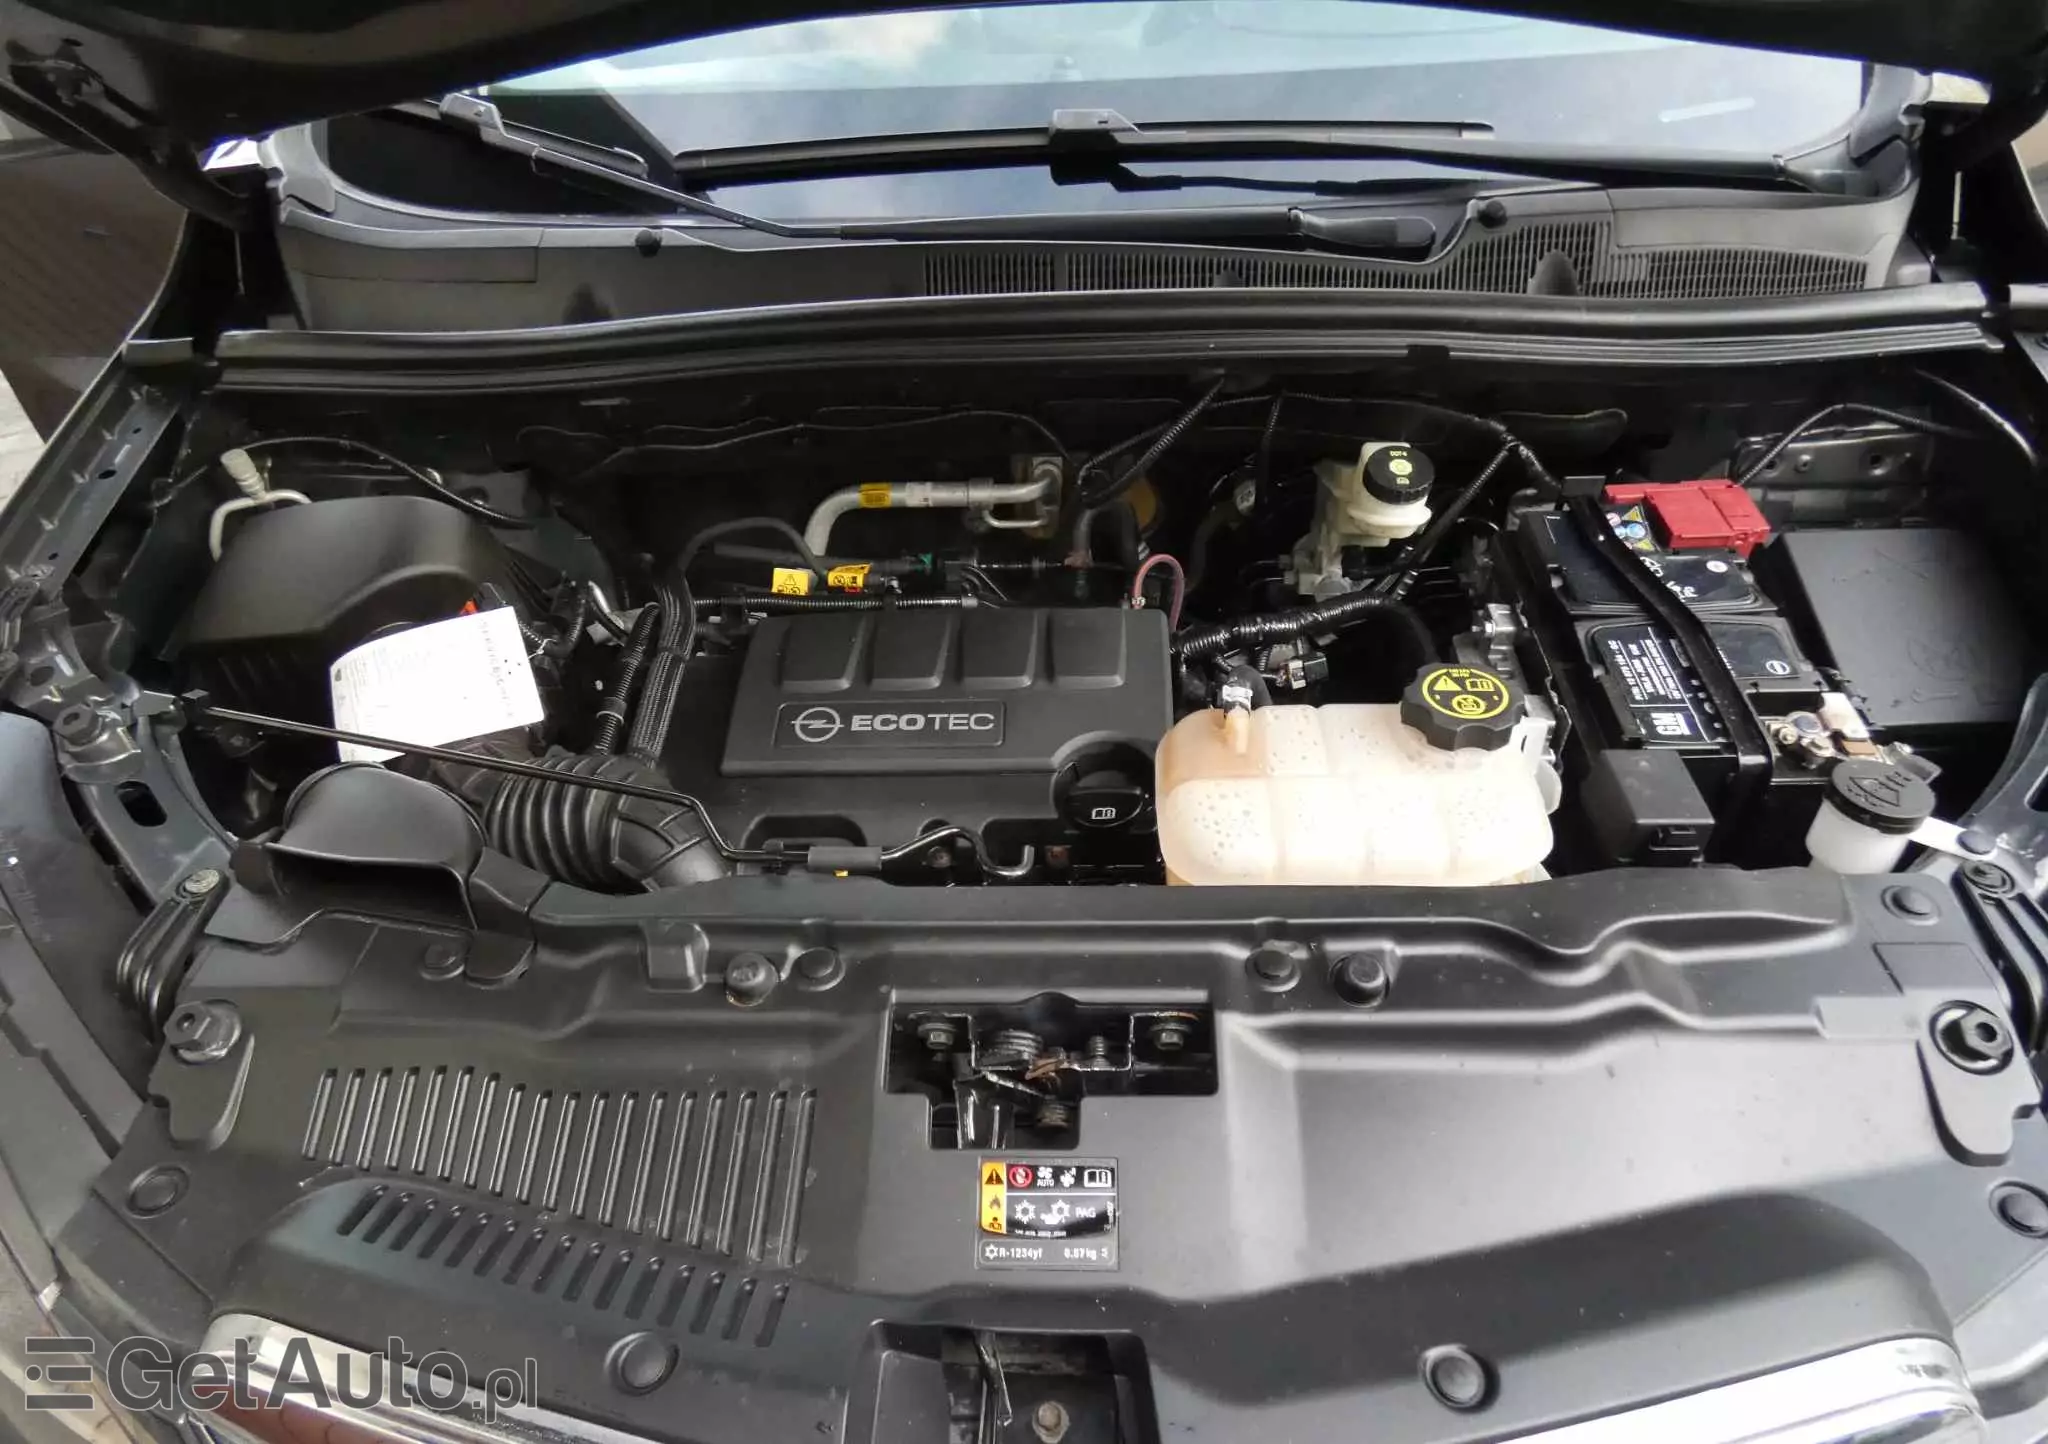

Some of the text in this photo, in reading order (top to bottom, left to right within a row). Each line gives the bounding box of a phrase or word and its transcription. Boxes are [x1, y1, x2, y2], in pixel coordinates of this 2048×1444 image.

[850, 713, 996, 731] ECOTEC
[1037, 1179, 1054, 1187] AUTO
[1075, 1206, 1097, 1218] PAG
